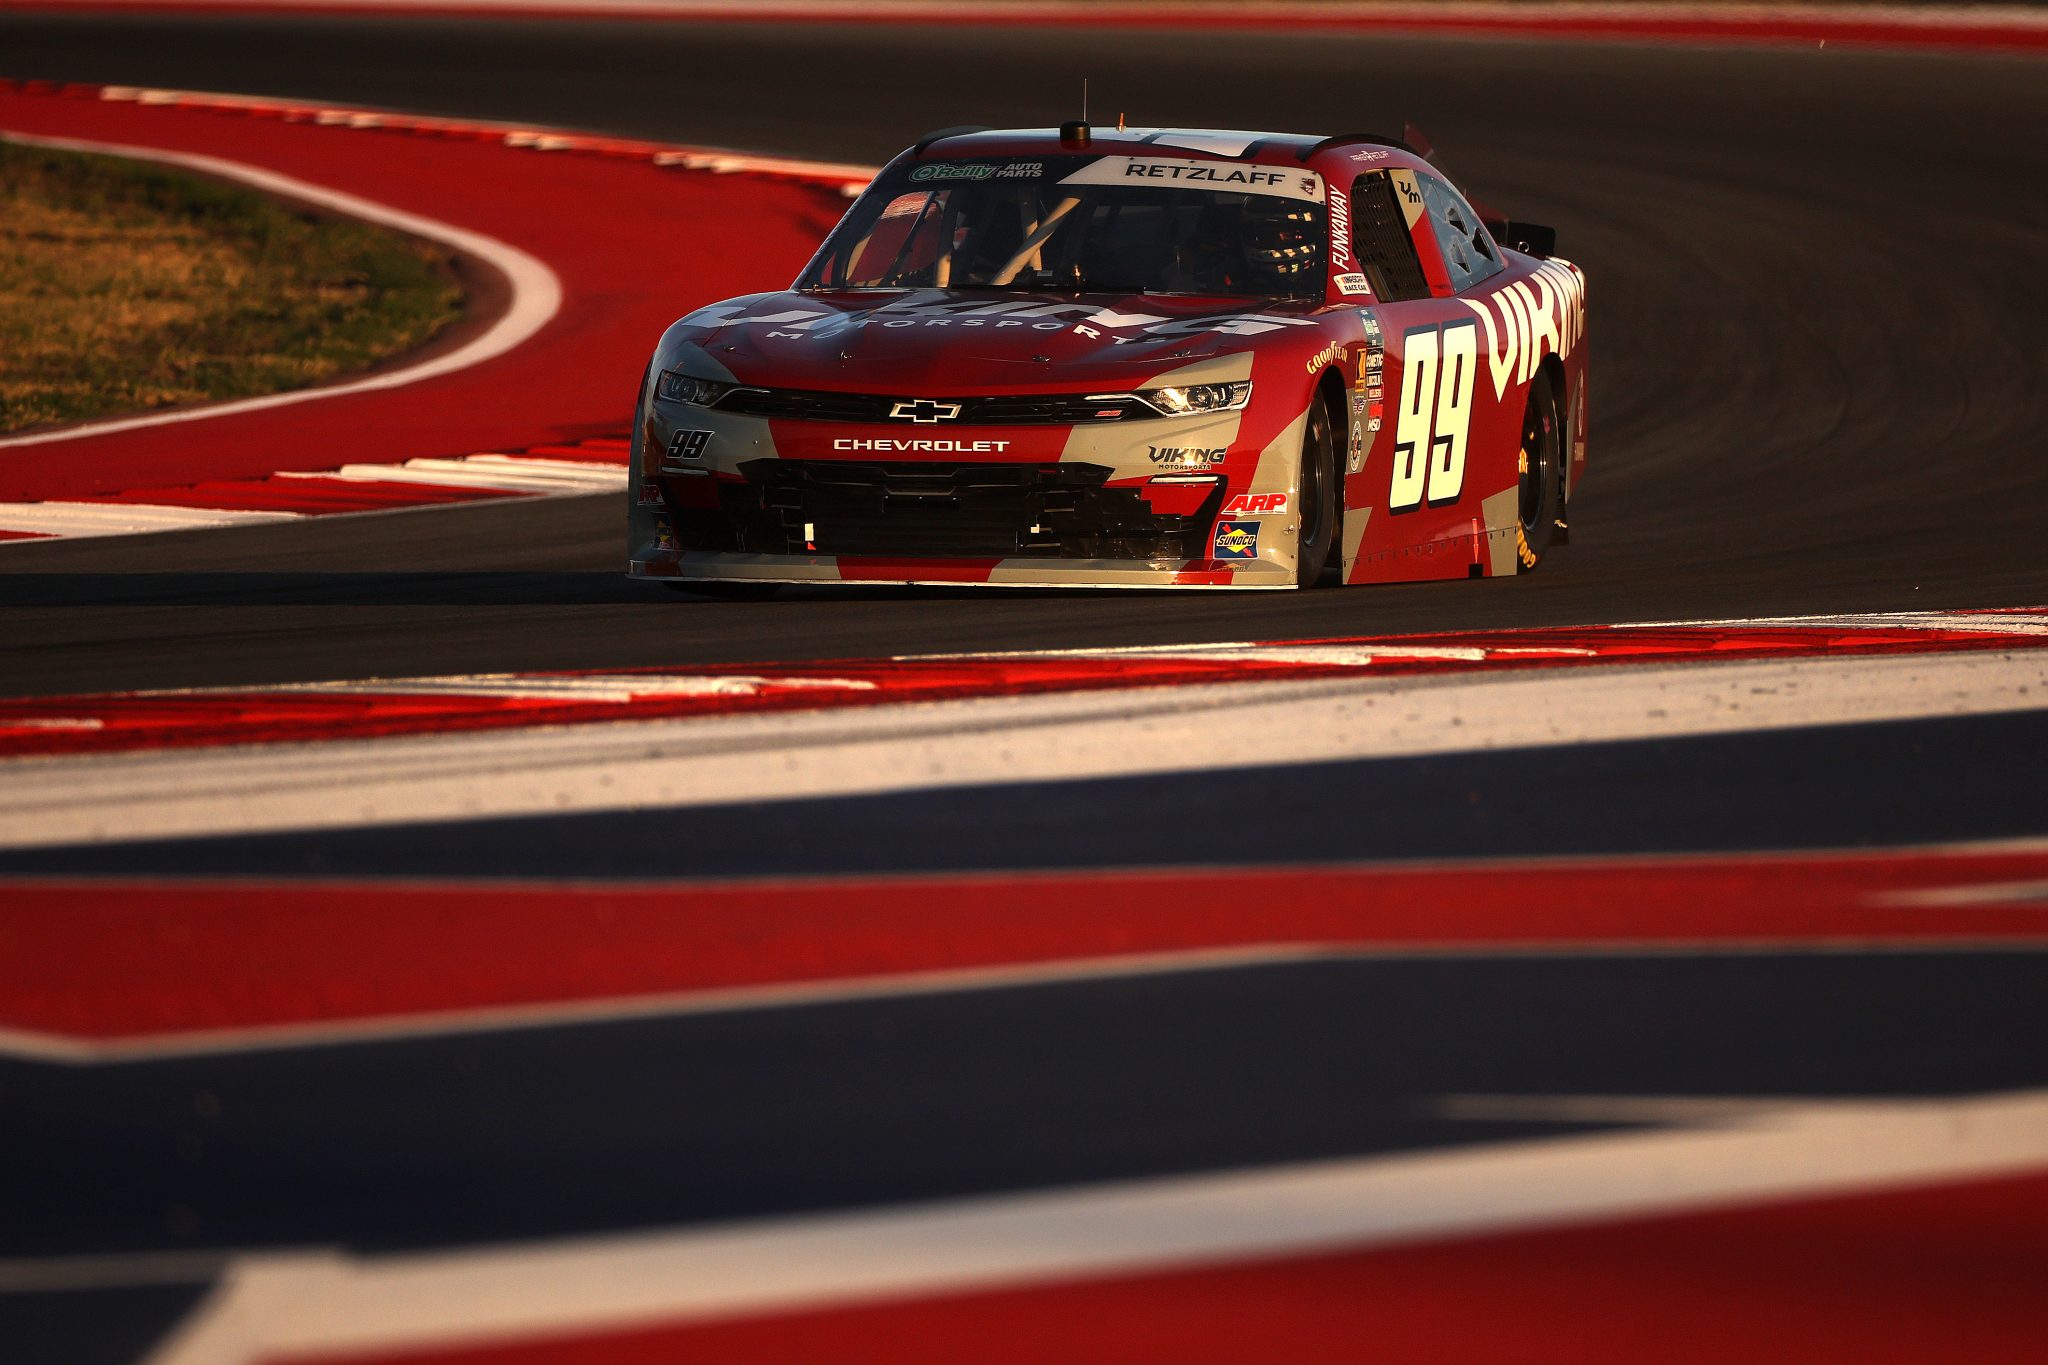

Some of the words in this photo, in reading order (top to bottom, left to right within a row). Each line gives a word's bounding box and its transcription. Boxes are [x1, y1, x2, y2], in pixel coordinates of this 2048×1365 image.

[911, 164, 998, 181] O'Reilly
[1005, 162, 1042, 171] AUTO
[995, 169, 1042, 178] PARTS
[1126, 164, 1286, 186] RETZLAFF
[1329, 184, 1350, 271] FUNKAWAY
[1306, 340, 1348, 374] GOODYEAR
[1389, 317, 1477, 515] 99
[663, 429, 717, 459] 99
[833, 438, 1010, 453] CHEVROLET
[1147, 445, 1227, 463] VIKING
[1158, 463, 1212, 471] MOTORSPORTS
[1224, 493, 1288, 512] ARP
[1217, 536, 1255, 546] SUNOCO
